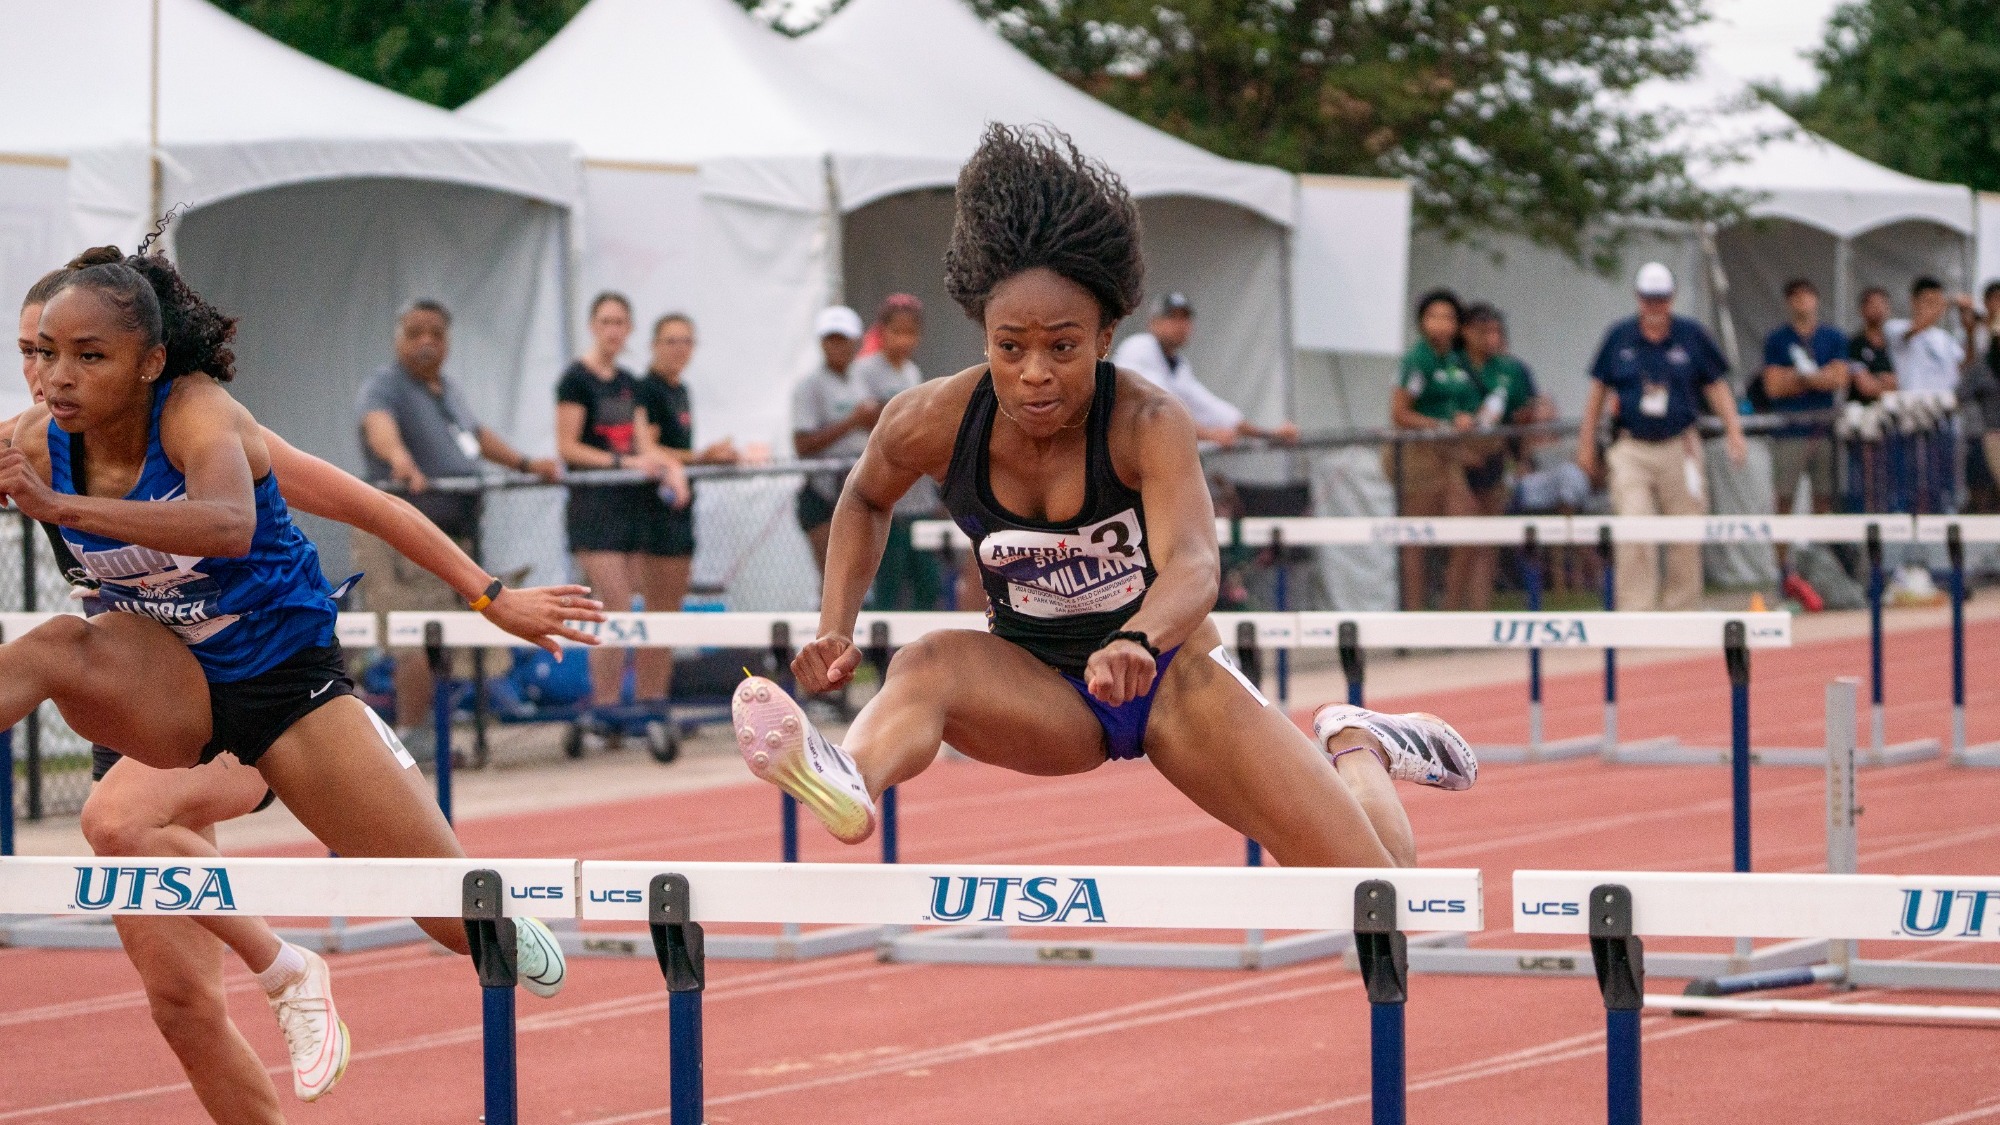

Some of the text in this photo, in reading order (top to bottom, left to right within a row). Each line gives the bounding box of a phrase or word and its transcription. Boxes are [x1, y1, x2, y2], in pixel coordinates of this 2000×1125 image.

[1091, 520, 1136, 558] 3
[991, 545, 1084, 560] AMERIC
[1020, 558, 1133, 596] MILLAN
[1077, 593, 1093, 603] FIELD
[1093, 573, 1138, 597] CHAMPIONSHIPS
[1033, 597, 1049, 605] PARK
[1064, 599, 1095, 609] ATHLETICS
[1094, 589, 1121, 603] COMPLEX
[1492, 619, 1588, 643] UTSA
[73, 866, 238, 911] UTSA
[510, 886, 564, 899] UCS
[589, 889, 643, 903] UCS
[929, 876, 1109, 923] UTSA
[1408, 899, 1466, 913] UCS
[1521, 902, 1580, 915] UCS
[1900, 888, 2000, 938] UT
[1517, 955, 1576, 971] UCS
